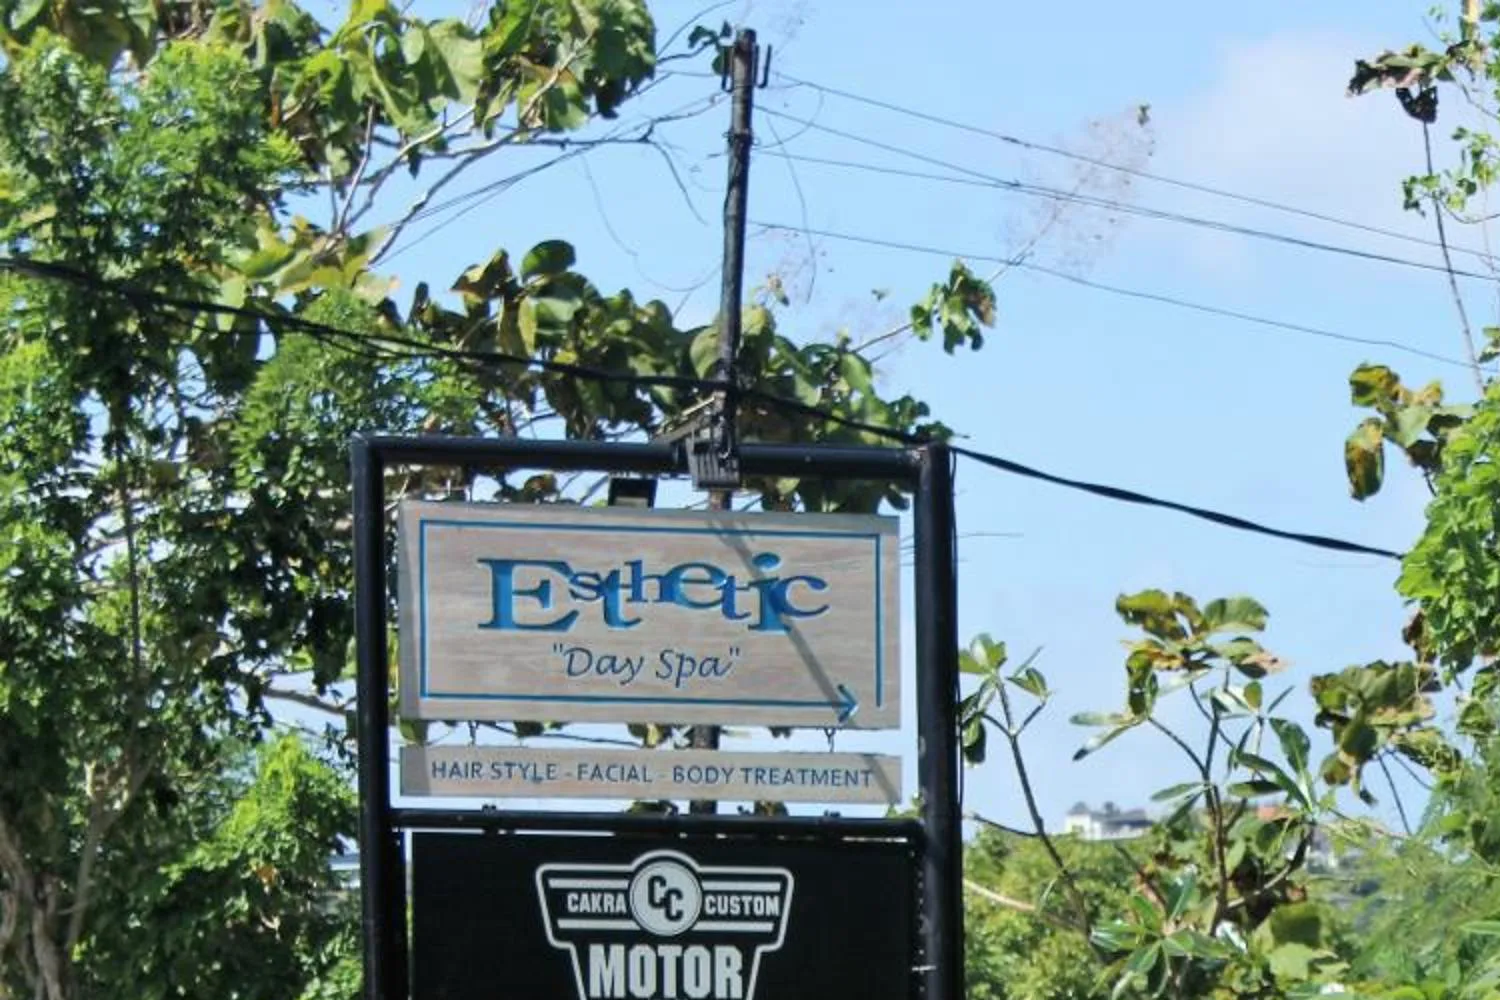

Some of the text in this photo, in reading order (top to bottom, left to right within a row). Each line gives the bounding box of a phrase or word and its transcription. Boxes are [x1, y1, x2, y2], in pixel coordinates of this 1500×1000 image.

[476, 551, 829, 633] Esthetic
[431, 760, 483, 781] HAIR
[491, 761, 557, 784] STYLE
[577, 763, 653, 784] FACIAL
[673, 765, 733, 786] BODY
[742, 767, 874, 788] TREATMENT
[567, 892, 627, 914] CAKRA
[705, 895, 780, 916] CUSTOM
[589, 943, 743, 1000] MOTOR
